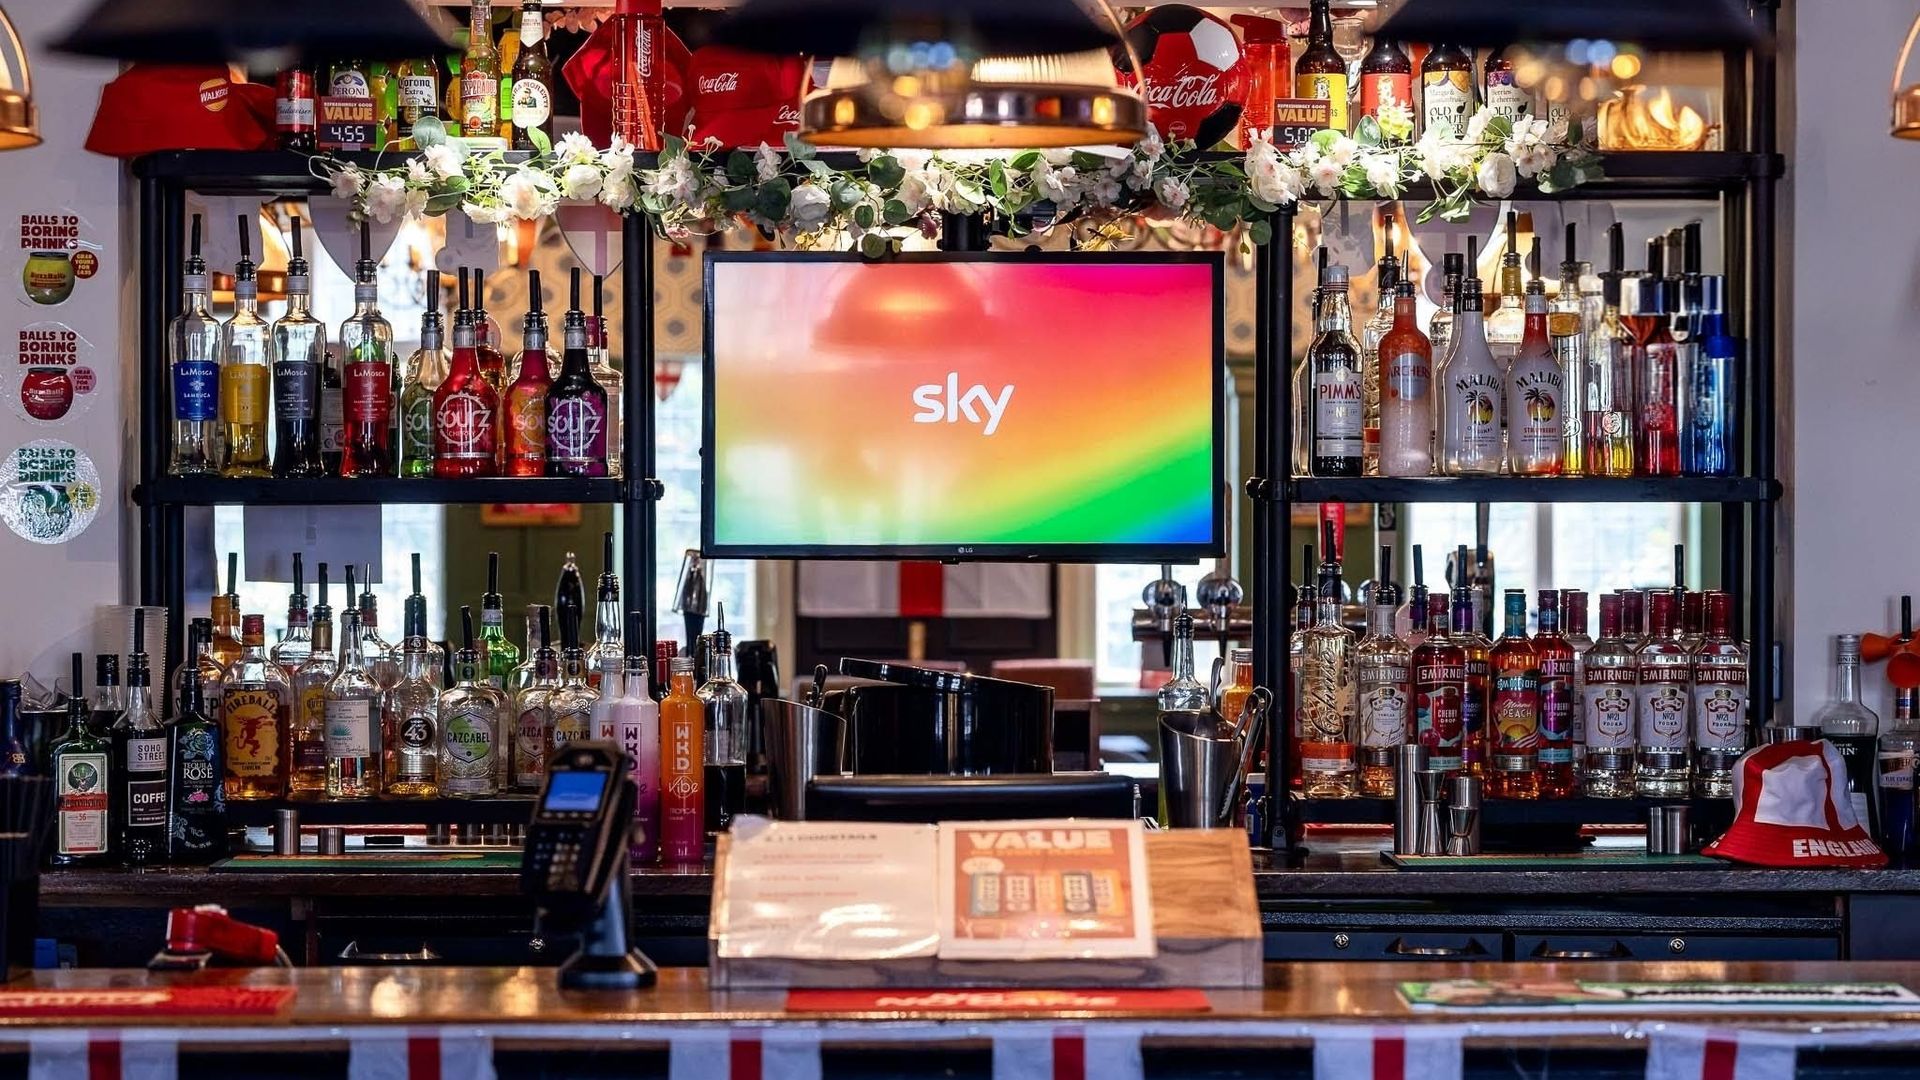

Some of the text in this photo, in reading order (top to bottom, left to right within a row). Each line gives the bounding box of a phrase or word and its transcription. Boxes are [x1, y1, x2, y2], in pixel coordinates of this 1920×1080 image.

[331, 86, 366, 96] PERONI
[324, 107, 373, 121] VALUE
[1277, 109, 1326, 123] VALUE
[1429, 107, 1451, 117] OLD
[331, 126, 365, 142] 4.55
[21, 215, 79, 225] BALLS TO
[21, 225, 79, 237] BORING
[21, 238, 79, 249] DRINKS
[19, 331, 77, 341] BALLS TO
[19, 342, 77, 352] BORING
[19, 354, 77, 365] DRINKS
[1320, 381, 1361, 399] PIMM'S
[912, 372, 1016, 436] sky
[59, 448, 76, 458] TO
[226, 694, 277, 716] FIREBALL
[1503, 709, 1532, 718] PEACH
[404, 725, 428, 741] 43
[447, 731, 491, 743] CAZCABEL
[138, 744, 161, 752] SOHO
[676, 726, 690, 770] WKD
[183, 767, 214, 780] ROSE
[968, 829, 1113, 850] VALUE
[1792, 838, 1880, 858] ENGLAND
